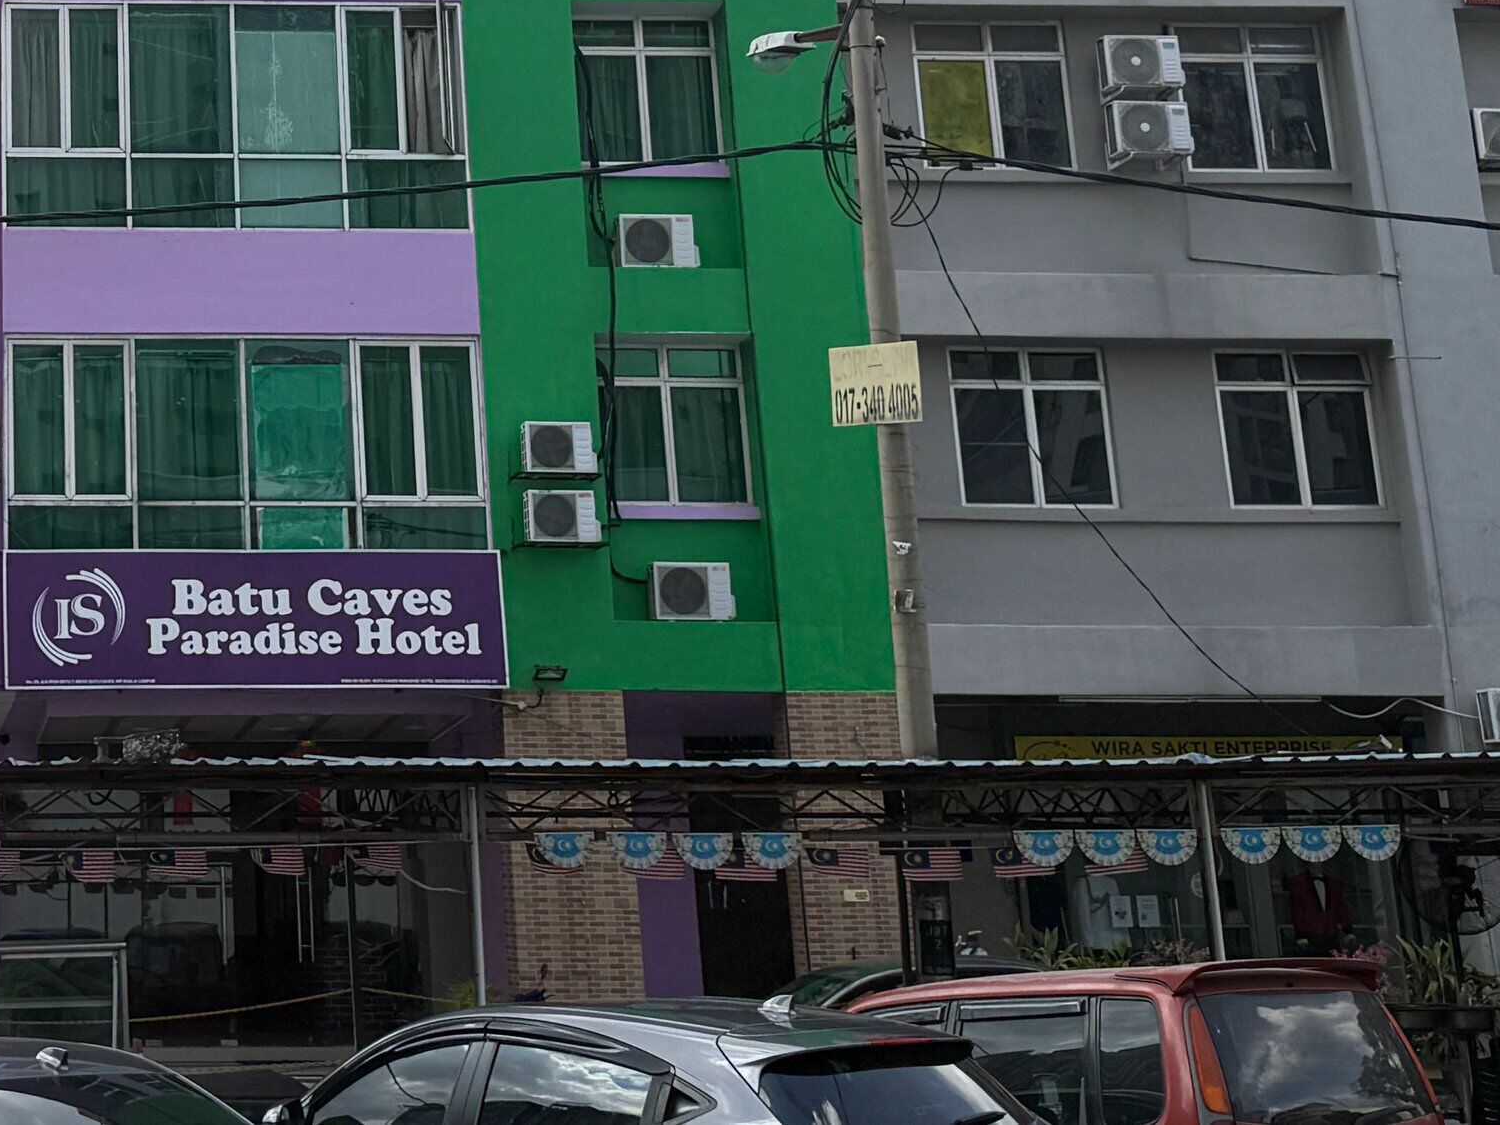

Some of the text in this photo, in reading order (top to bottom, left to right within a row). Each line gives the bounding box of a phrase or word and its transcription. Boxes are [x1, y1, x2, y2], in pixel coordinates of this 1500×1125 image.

[888, 382, 919, 421] 4005
[171, 578, 453, 616] Batu Caves
[53, 593, 105, 640] IS
[145, 617, 483, 655] Paradise Hotel
[1091, 740, 1146, 756] WIRA
[1151, 740, 1208, 756] SAKTI
